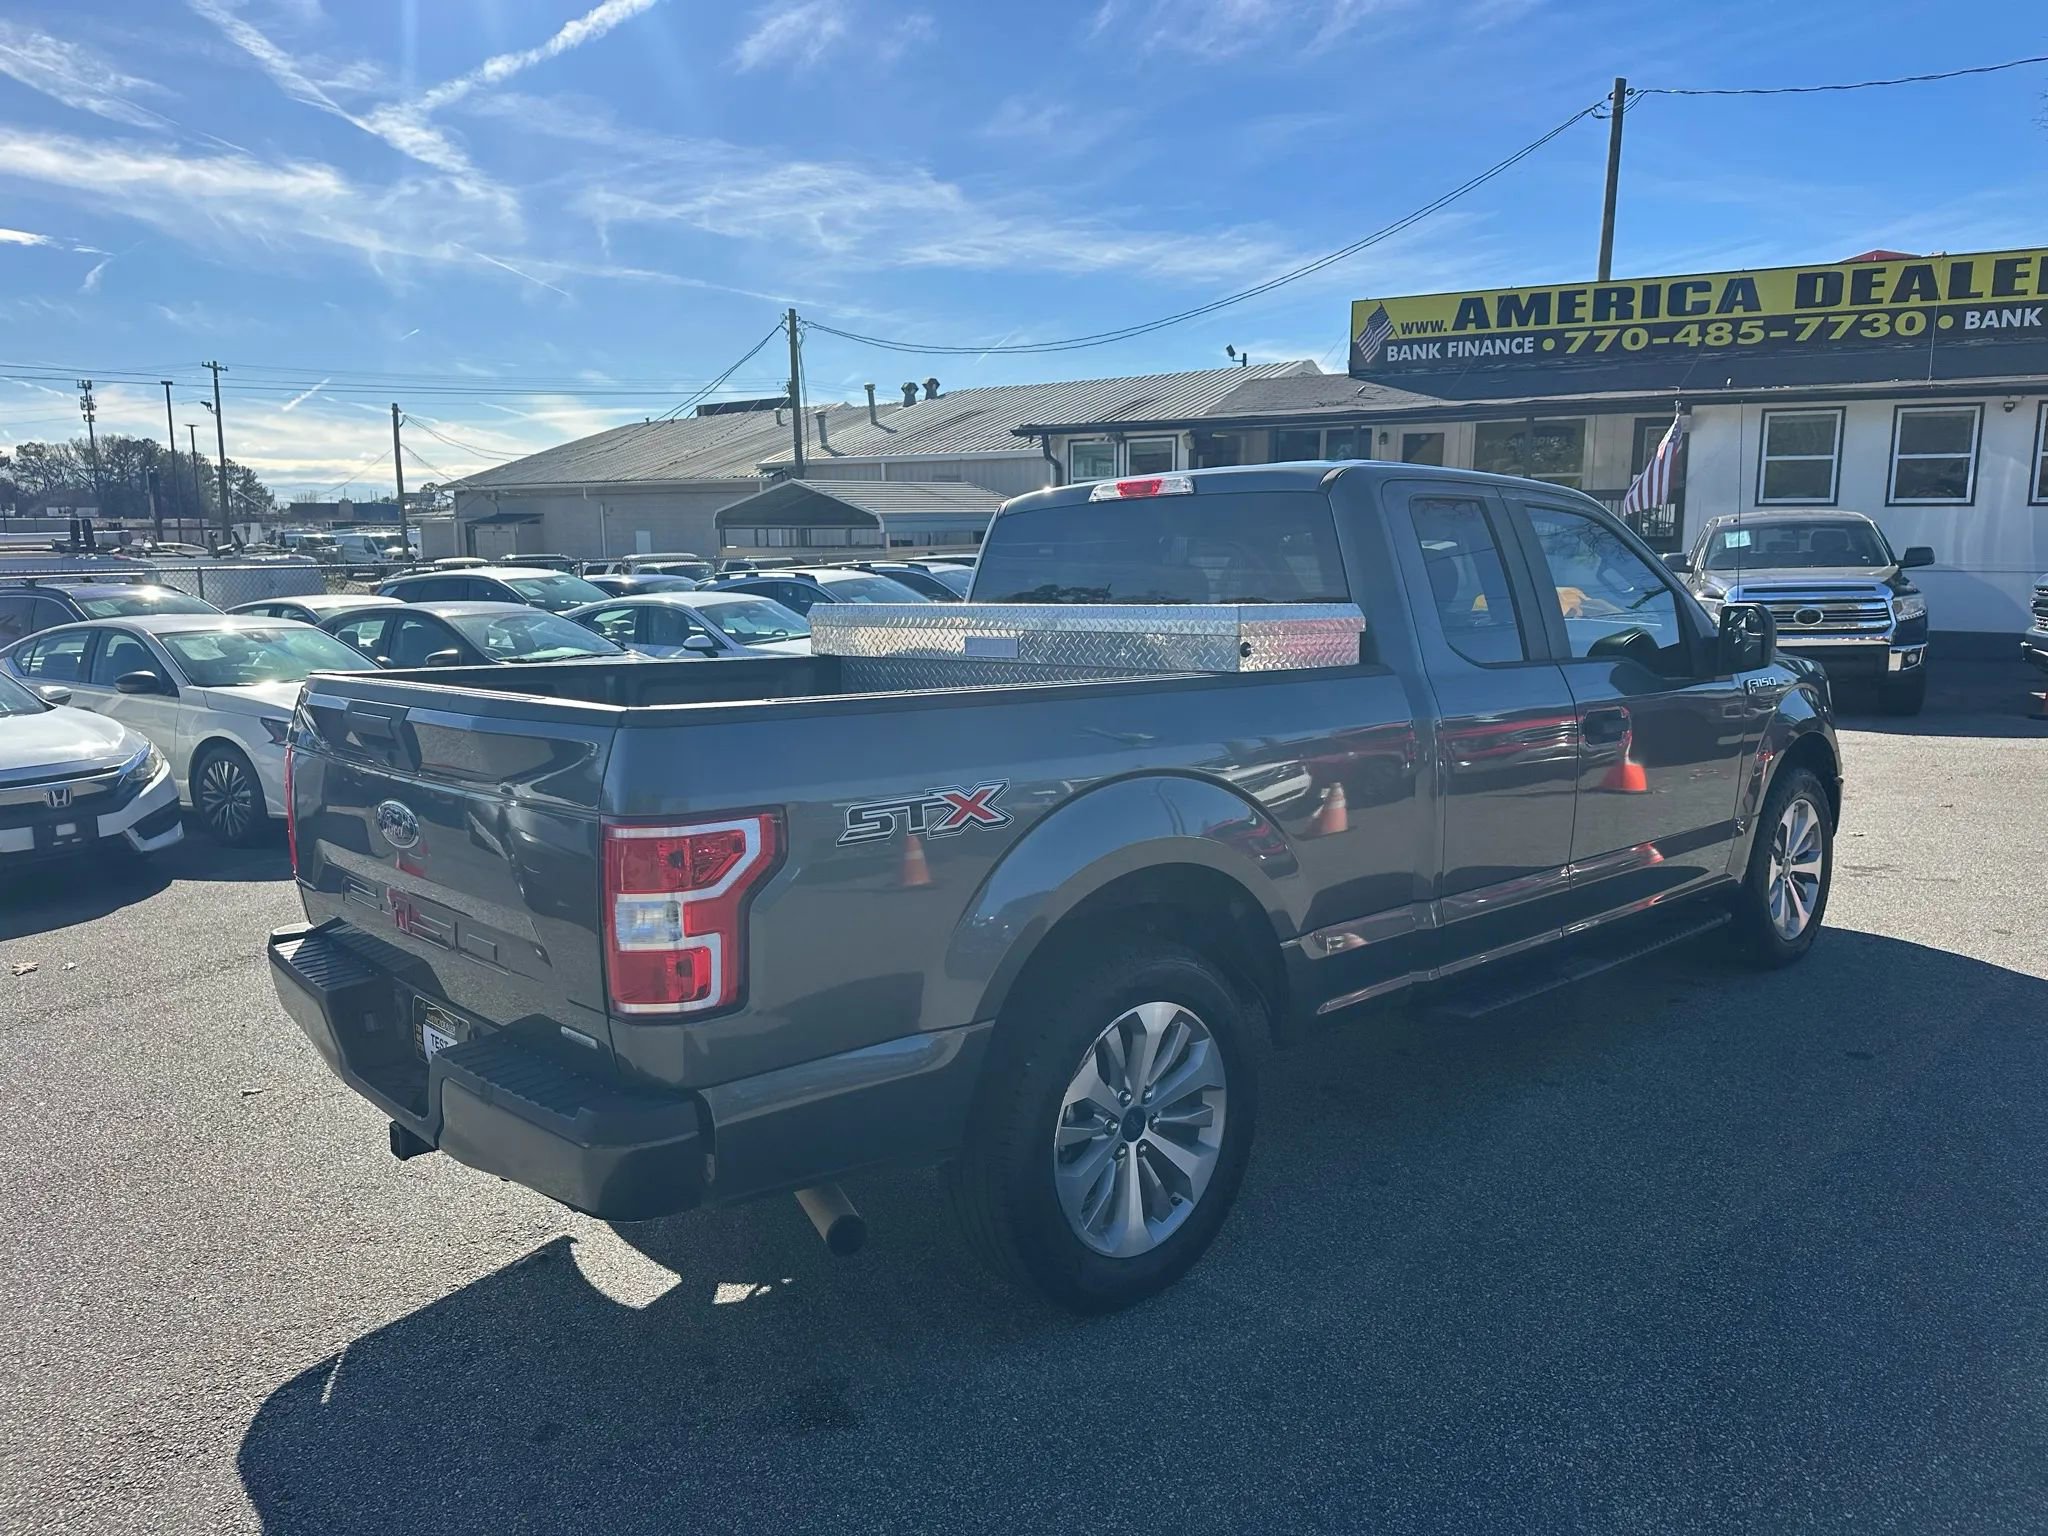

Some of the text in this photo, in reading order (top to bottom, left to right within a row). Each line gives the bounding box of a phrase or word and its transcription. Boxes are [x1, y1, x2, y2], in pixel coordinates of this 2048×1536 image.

[1795, 255, 2048, 309] DEALE
[1564, 310, 1927, 354] 770-485-7730
[1964, 307, 2043, 330] BANK
[1386, 336, 1534, 362] BANK FINANCE
[835, 778, 1014, 847] STX
